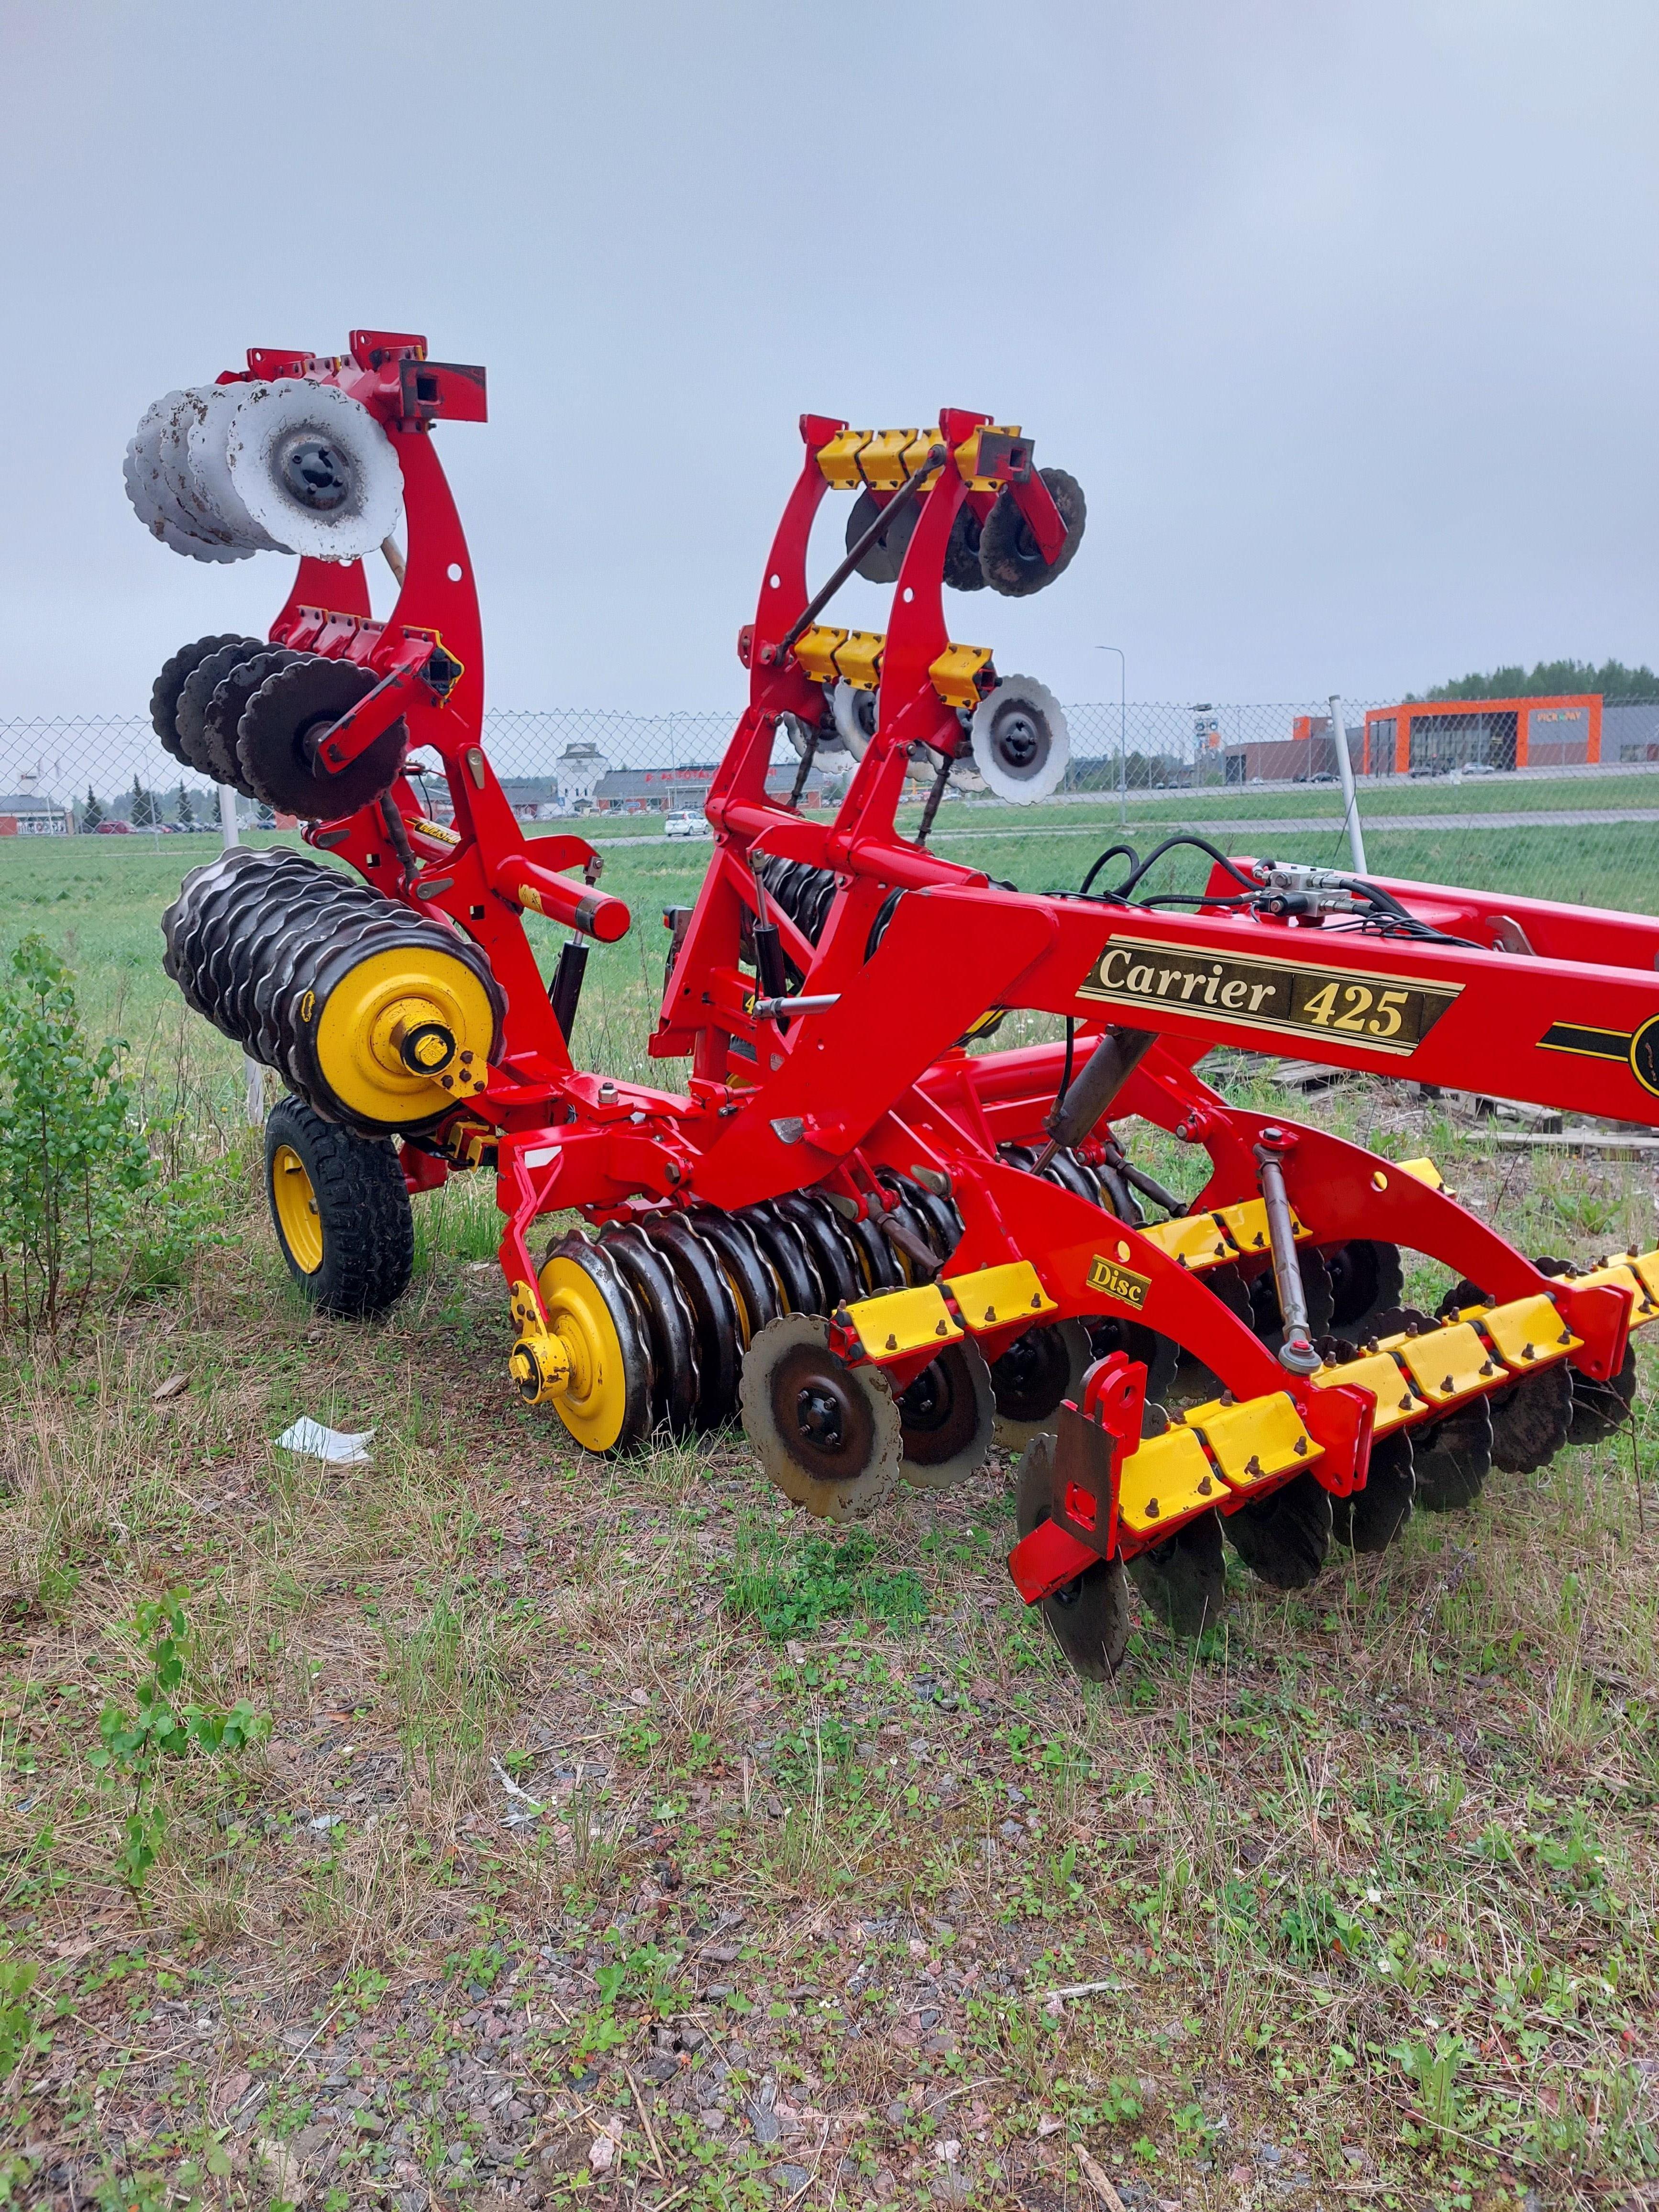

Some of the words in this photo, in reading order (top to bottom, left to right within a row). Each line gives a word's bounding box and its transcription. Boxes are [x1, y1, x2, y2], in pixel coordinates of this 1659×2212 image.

[1100, 949, 1276, 1012] Carrier
[1303, 983, 1409, 1037] 425
[1092, 1262, 1142, 1302] Disc
